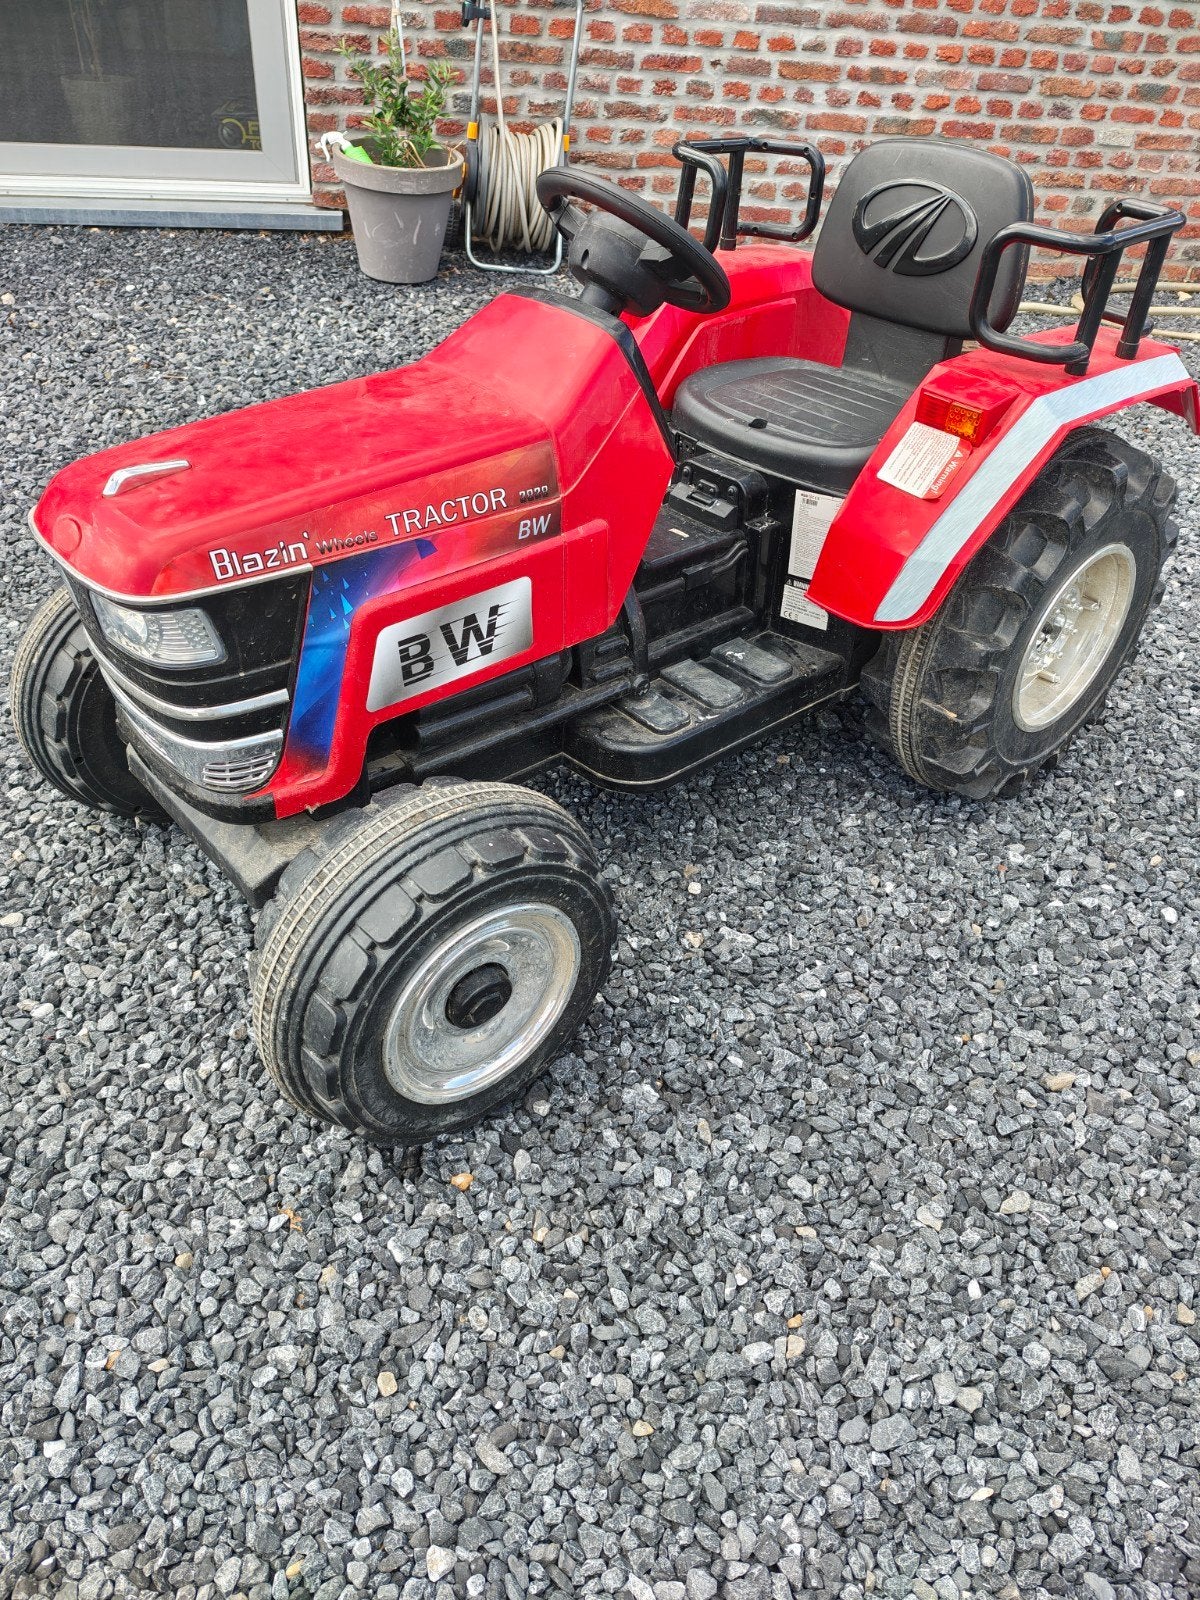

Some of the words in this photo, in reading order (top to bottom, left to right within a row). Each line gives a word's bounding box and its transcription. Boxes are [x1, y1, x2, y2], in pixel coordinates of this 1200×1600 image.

[931, 460, 957, 494] Warning!
[209, 532, 310, 580] Blazin'
[316, 530, 378, 555] Wheels
[385, 487, 508, 536] TRACTOR
[518, 514, 552, 540] BW
[397, 603, 501, 687] BW
